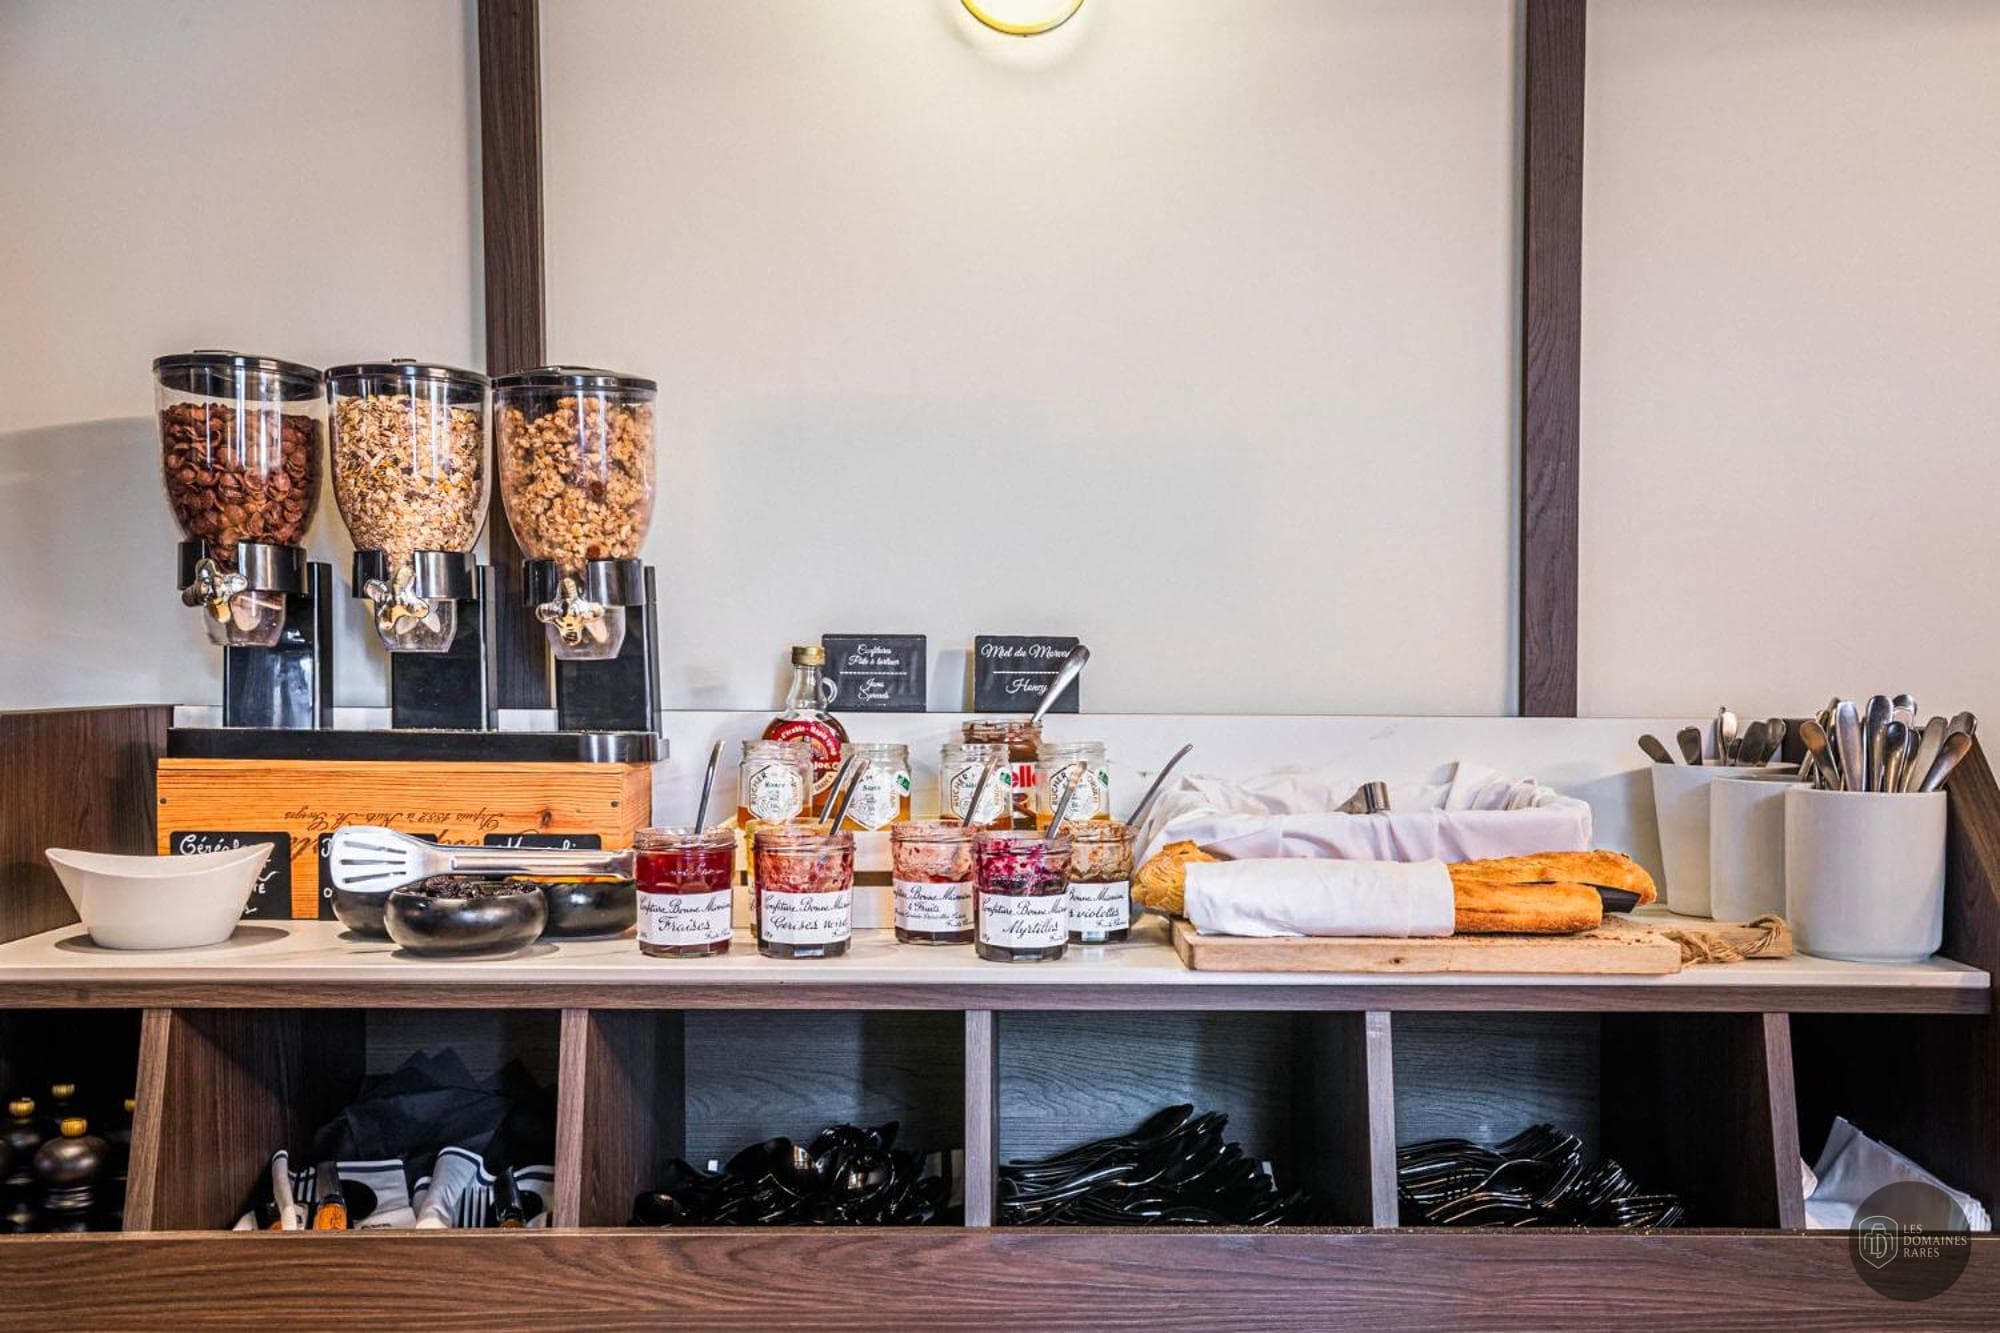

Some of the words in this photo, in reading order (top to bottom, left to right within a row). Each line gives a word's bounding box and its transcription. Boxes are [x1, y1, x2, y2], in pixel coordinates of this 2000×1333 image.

[980, 643, 1012, 659] Miel
[1014, 646, 1027, 657] du
[1004, 678, 1048, 696] Honey
[668, 898, 700, 914] Bonne
[658, 915, 711, 932] Fraises
[769, 915, 818, 931] Cerises
[1002, 919, 1058, 940] Myrtilles
